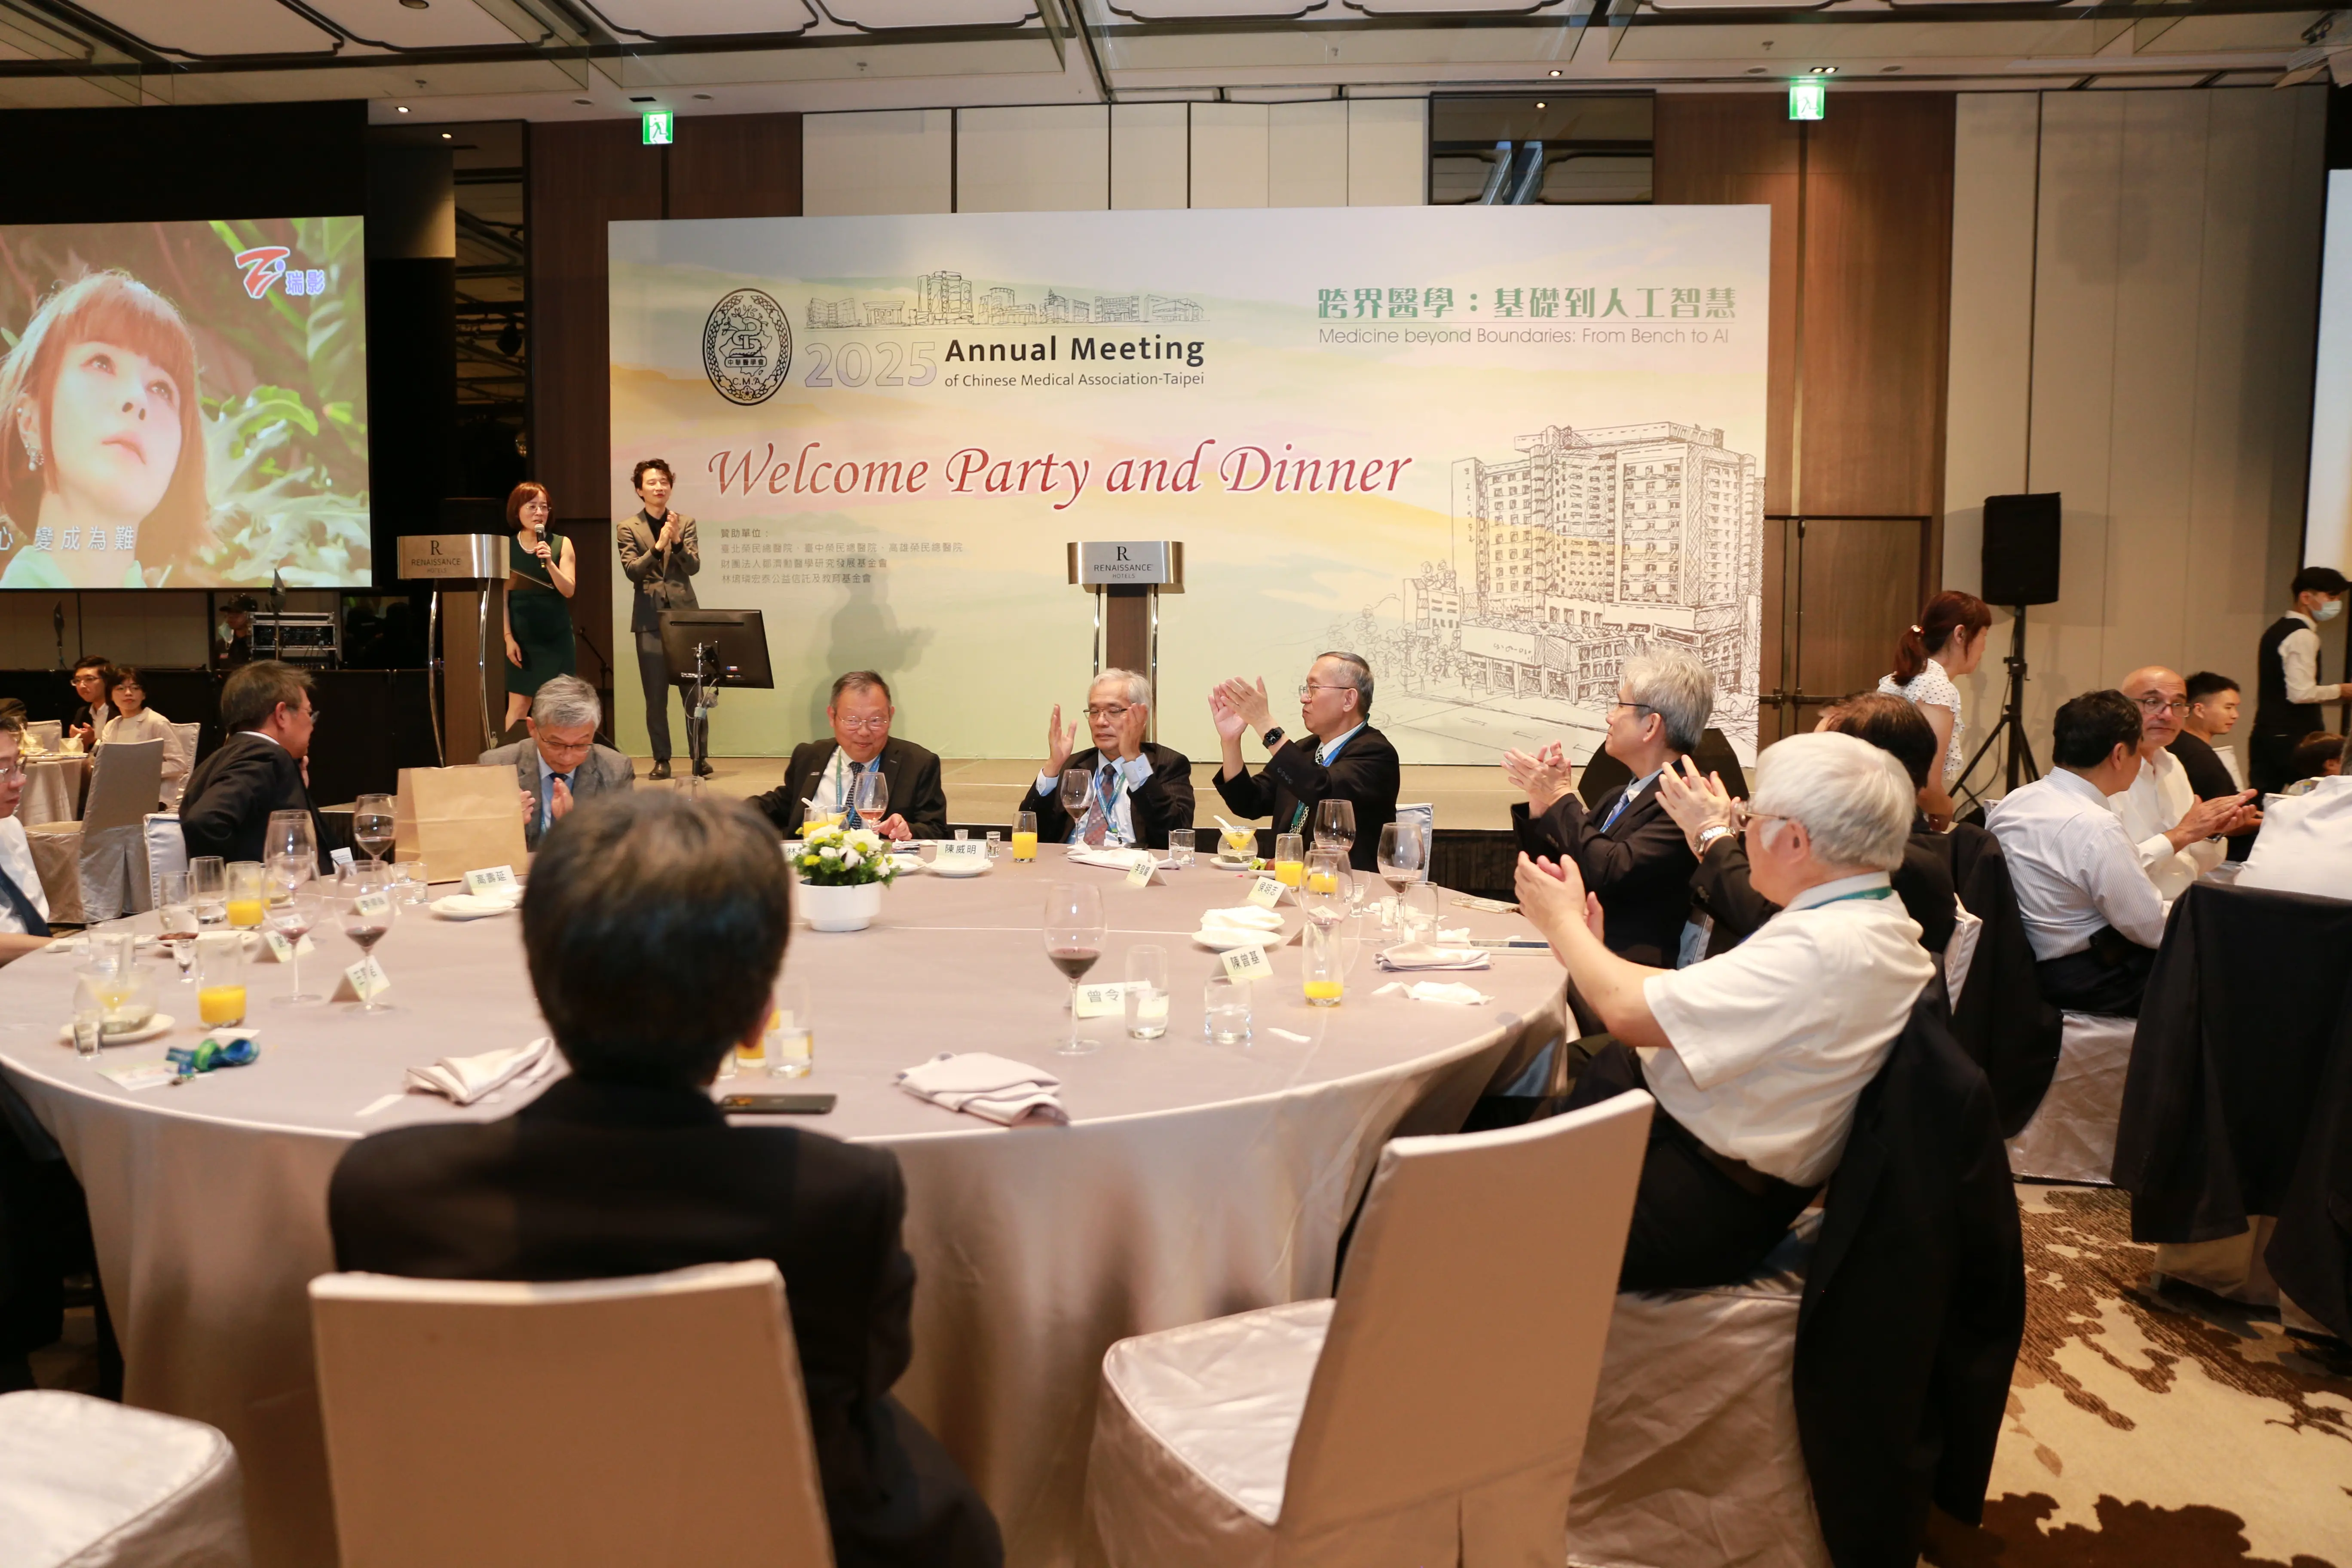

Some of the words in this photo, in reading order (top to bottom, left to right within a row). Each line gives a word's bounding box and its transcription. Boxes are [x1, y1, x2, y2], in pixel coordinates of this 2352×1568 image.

[285, 270, 325, 296] 瑞影
[1318, 287, 1736, 319] 跨界醫學：基礎到人工智慧
[1320, 328, 1399, 344] Medicine
[1405, 328, 1471, 346] beyond
[1477, 328, 1576, 343] Boundaries:
[1583, 328, 1625, 343] From
[1632, 328, 1685, 343] Bench
[1691, 328, 1708, 343] to
[1713, 328, 1728, 343] AI
[945, 335, 1057, 362] Annual
[1071, 334, 1205, 367] Meeting
[805, 342, 937, 387] 2025
[945, 374, 960, 387] of
[963, 373, 1017, 387] Chinese
[1021, 373, 1074, 386] Medical
[1078, 372, 1204, 388] Association-Taipei
[708, 443, 928, 496] Welcome
[945, 448, 1089, 510] Party
[1106, 439, 1216, 493] and
[1220, 444, 1413, 492] Dinner
[34, 526, 134, 551] 變成為難
[430, 540, 443, 555] R
[411, 558, 461, 566] RENAISSANCE
[1116, 546, 1131, 561] R
[945, 844, 977, 854] 陳威明
[1229, 950, 1260, 970] 陳曾基
